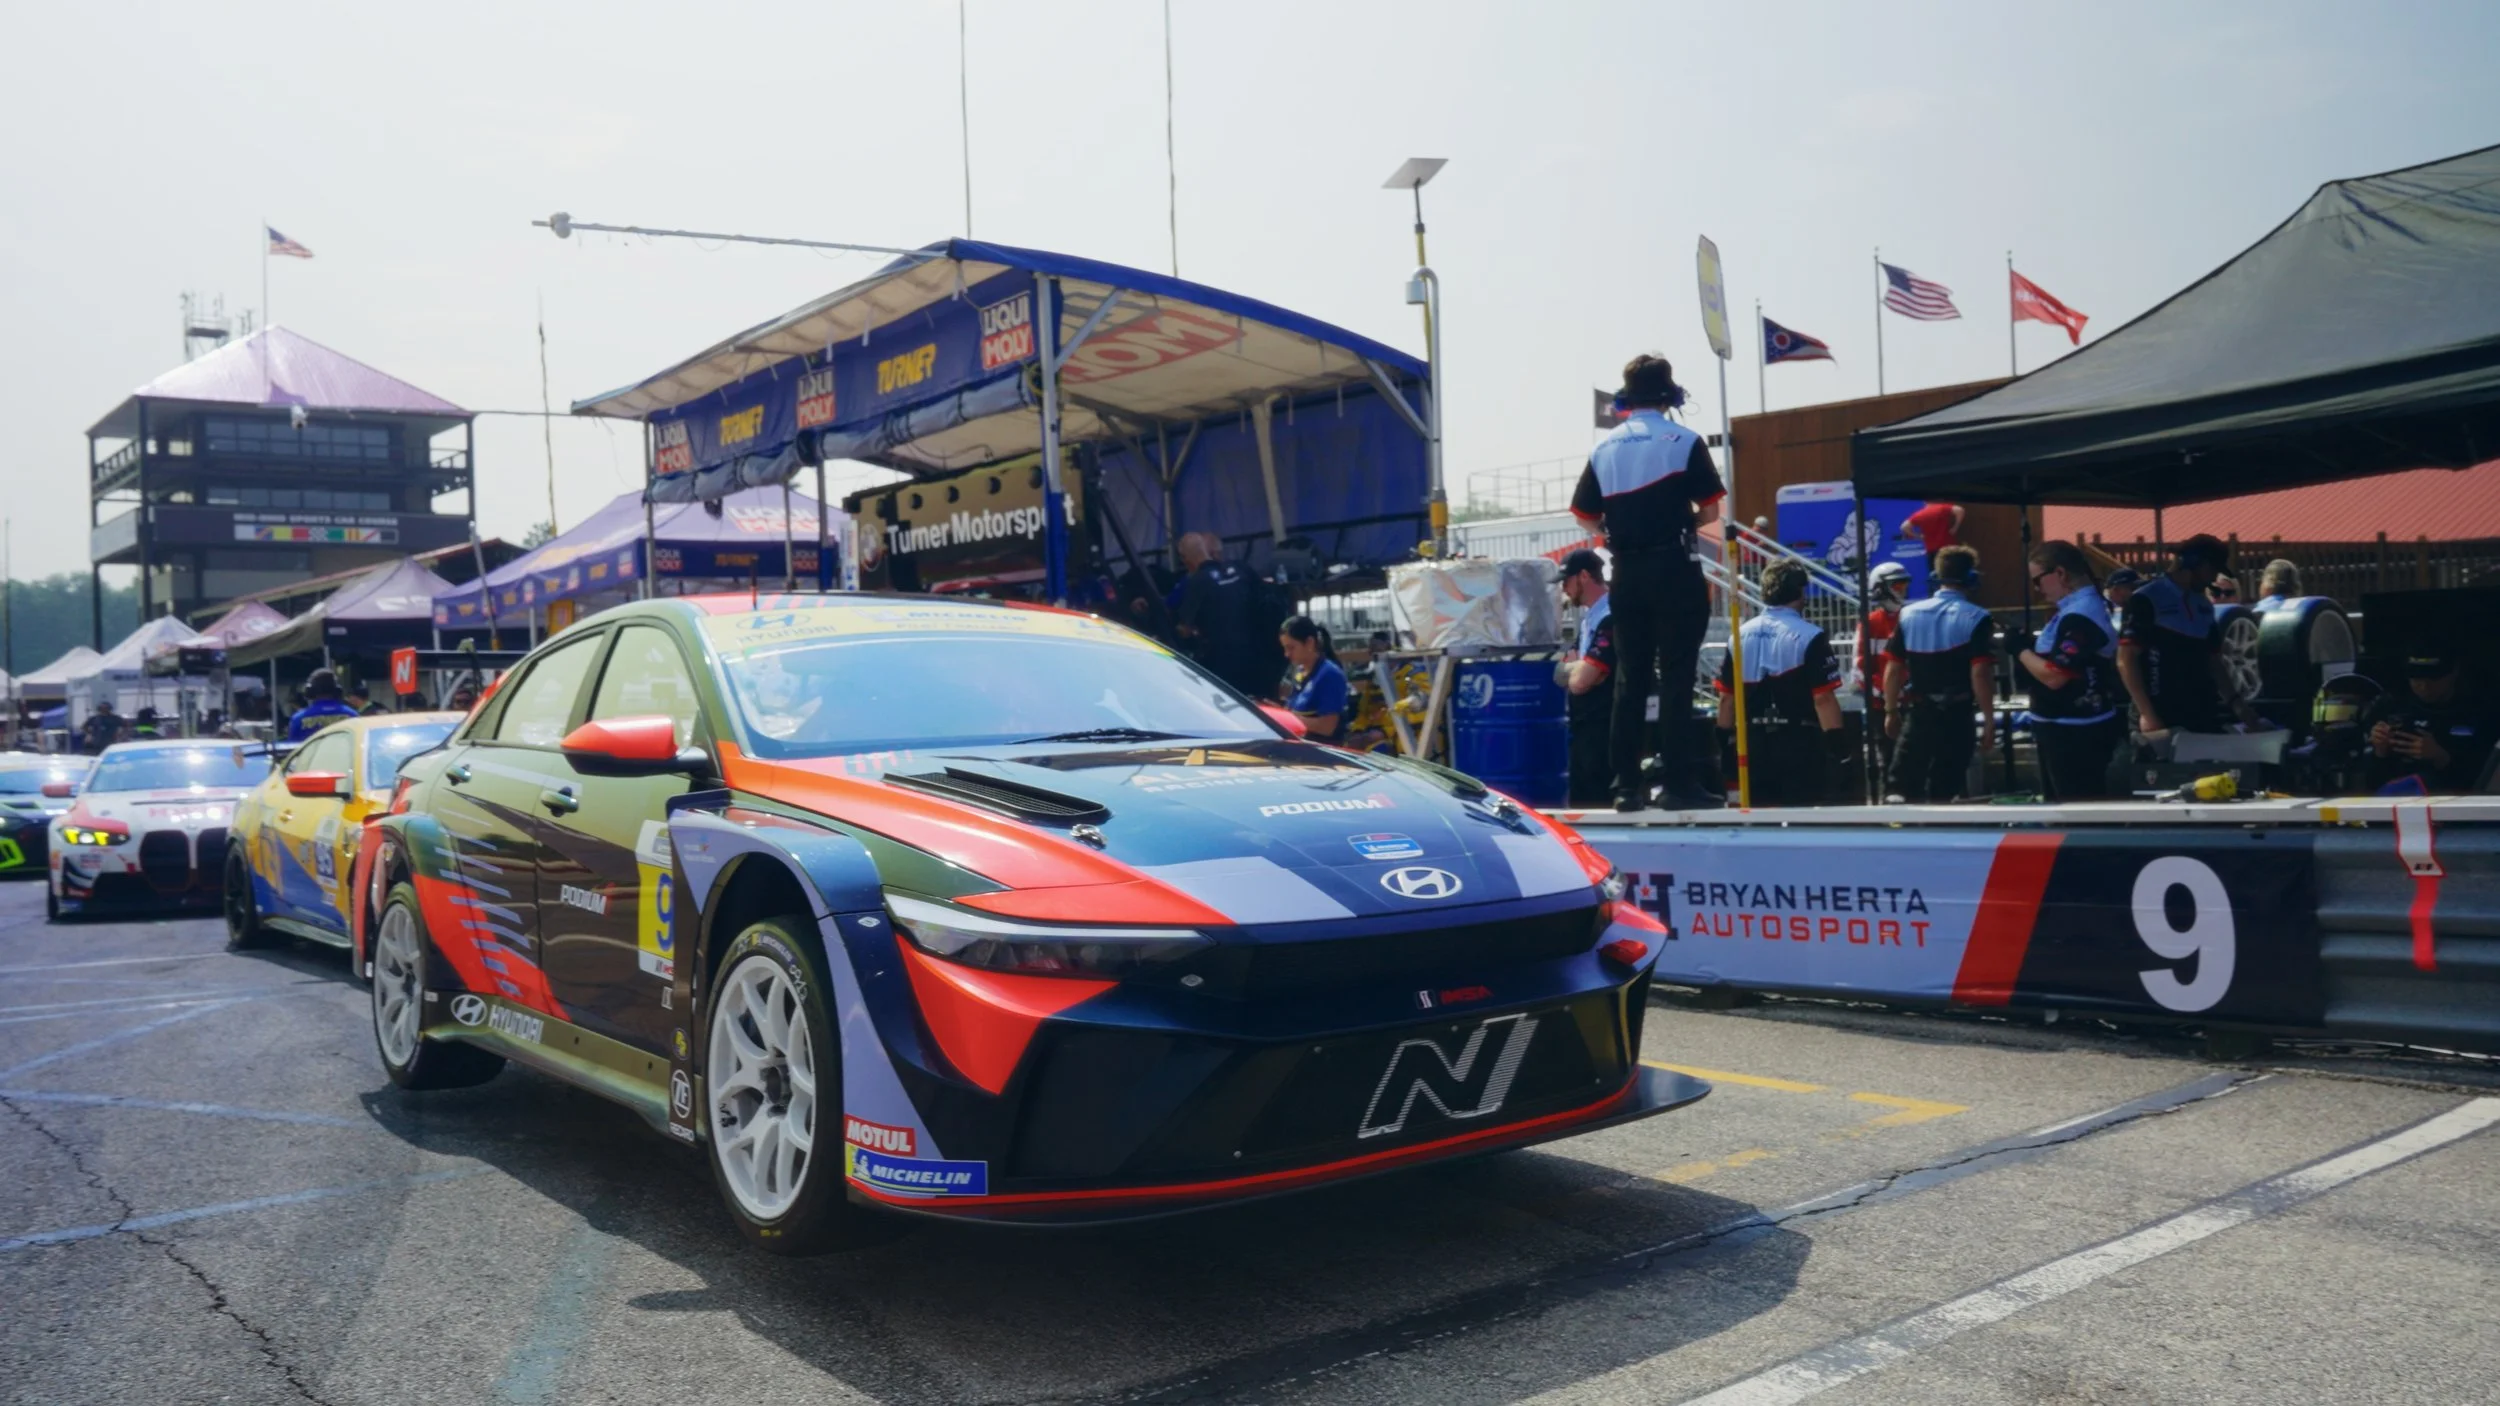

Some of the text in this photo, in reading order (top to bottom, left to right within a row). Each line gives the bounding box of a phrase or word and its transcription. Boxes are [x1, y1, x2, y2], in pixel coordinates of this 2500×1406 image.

[984, 296, 1031, 336] LIQUI
[984, 326, 1032, 368] MOLY
[877, 343, 937, 395] TURNER
[887, 493, 1076, 555] Turner Motorspt
[735, 625, 837, 645] HYUNDAI
[656, 872, 675, 952] 9
[1686, 881, 1929, 915] BRYAN HERTA
[1691, 911, 1931, 948] AUTOSPORT
[2131, 855, 2236, 1013] 9
[487, 1003, 545, 1045] HYUNDAI
[847, 1119, 912, 1153] MOTUL
[871, 1164, 972, 1185] MICHELIN
